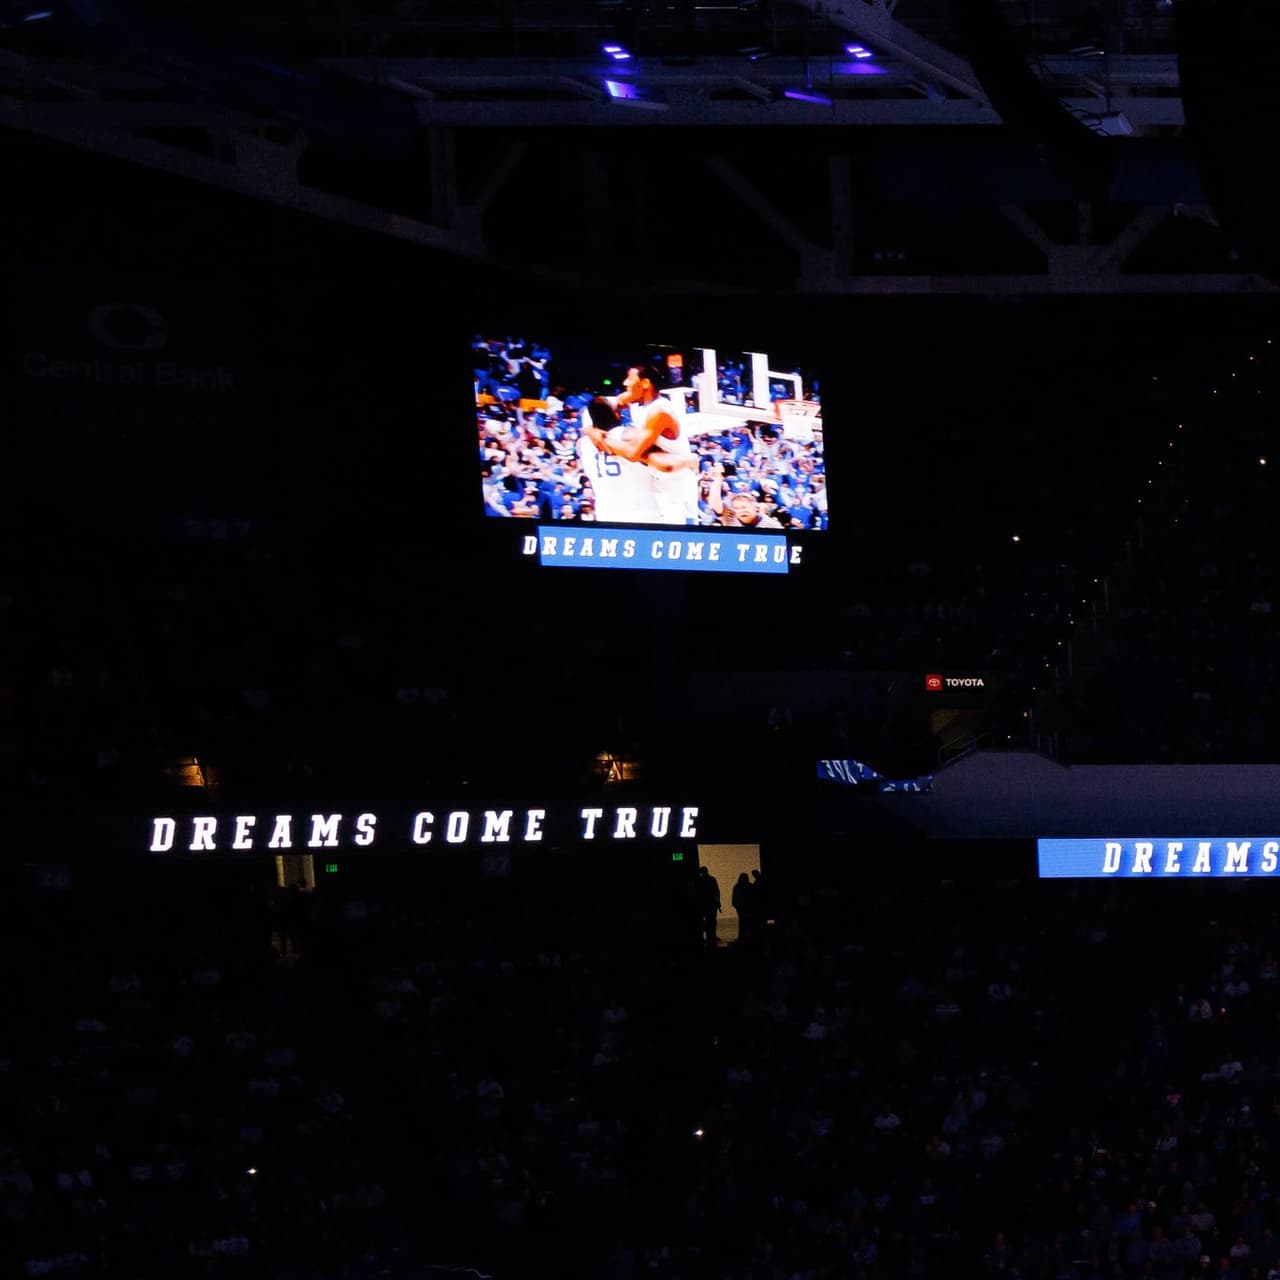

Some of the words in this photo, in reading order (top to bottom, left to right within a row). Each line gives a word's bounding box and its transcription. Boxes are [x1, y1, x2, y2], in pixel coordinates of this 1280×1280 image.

[523, 535, 636, 558] DREAMS
[651, 540, 721, 561] COME
[737, 543, 803, 564] TRUE
[945, 678, 985, 687] TOYOTA
[149, 812, 378, 852] DREAMS
[412, 808, 546, 844] COME
[580, 806, 700, 840] TRUE
[1102, 841, 1280, 873] DREAMS
